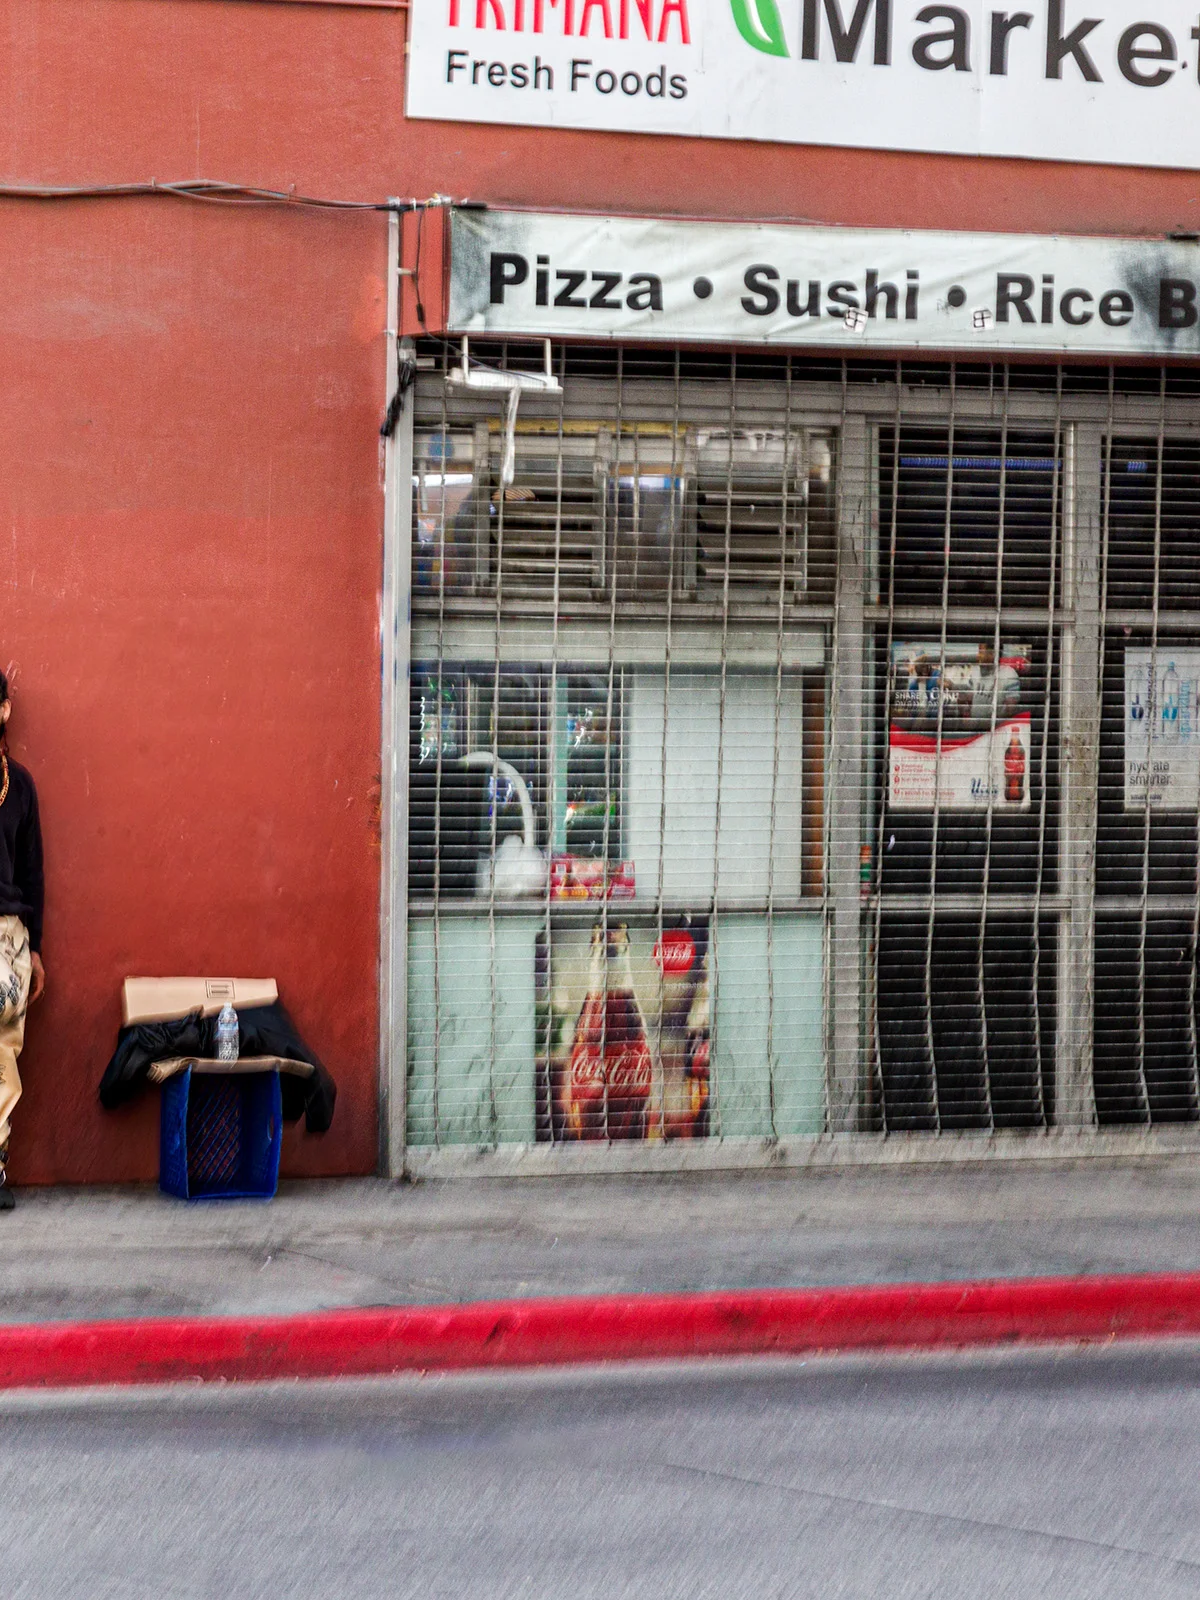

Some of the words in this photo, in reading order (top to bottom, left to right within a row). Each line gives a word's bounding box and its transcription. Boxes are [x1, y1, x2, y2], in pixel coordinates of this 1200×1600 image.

[447, 49, 554, 90] Fresh
[570, 58, 688, 99] Foods
[490, 251, 663, 311] Pizza
[740, 263, 919, 320] Sushi
[995, 272, 1134, 327] Rice
[1129, 759, 1170, 774] hydate
